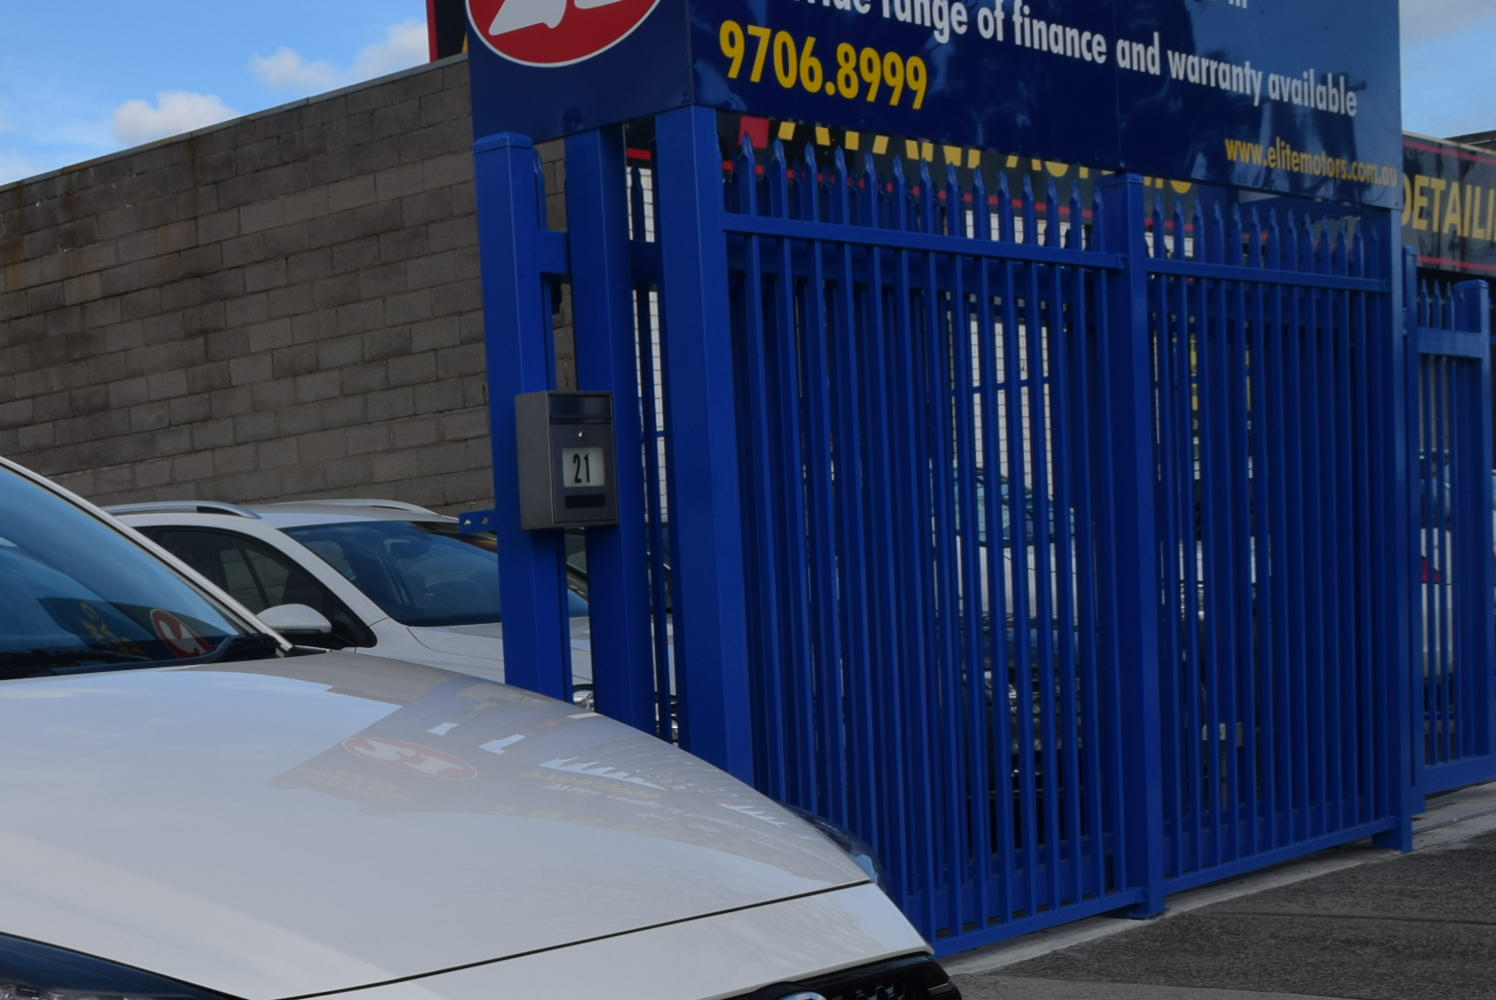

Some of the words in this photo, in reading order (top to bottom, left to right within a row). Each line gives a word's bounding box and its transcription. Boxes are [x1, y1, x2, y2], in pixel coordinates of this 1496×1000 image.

[719, 19, 928, 111] 9706.8999
[977, 0, 1005, 42] of
[1012, 0, 1108, 64] finance
[1116, 31, 1161, 76] and
[1167, 49, 1263, 107] warranty
[1268, 68, 1358, 117] available
[1224, 136, 1398, 187] www.elitemotors.com.au
[1401, 172, 1496, 243] DETAILI
[572, 453, 591, 484] 21
